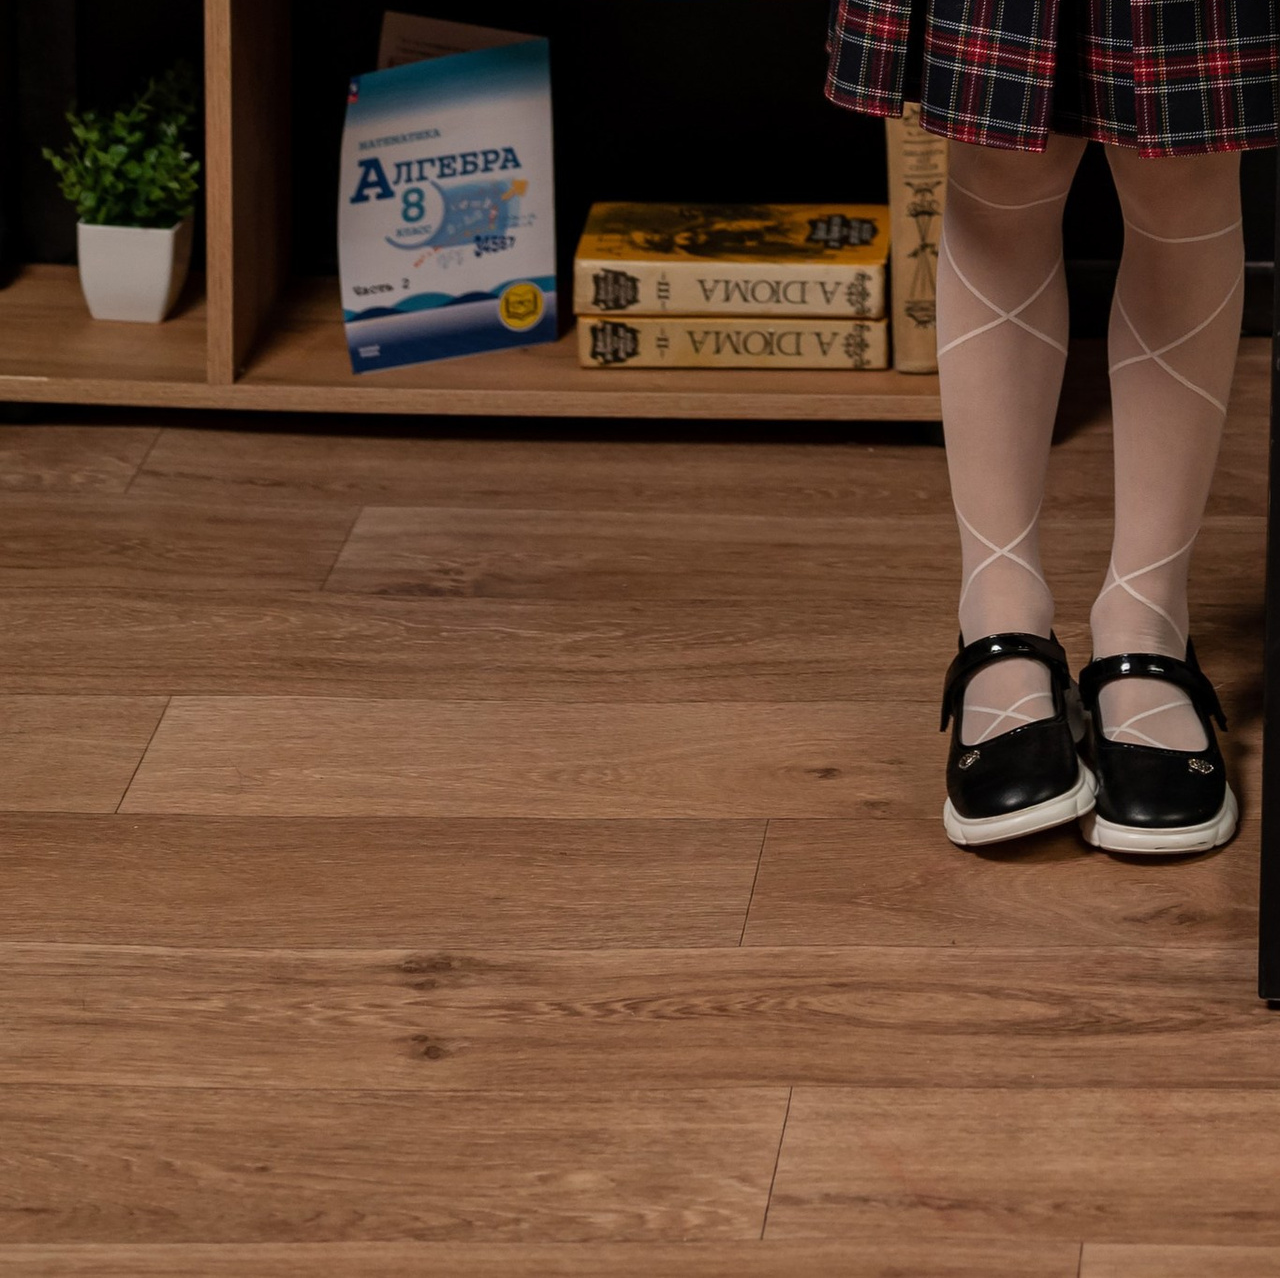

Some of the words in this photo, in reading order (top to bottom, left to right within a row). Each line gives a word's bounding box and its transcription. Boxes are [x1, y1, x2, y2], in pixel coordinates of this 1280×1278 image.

[358, 128, 442, 150] МАТЕМАТИКА
[349, 146, 523, 205] АЛГЕБРА
[402, 186, 426, 223] 8
